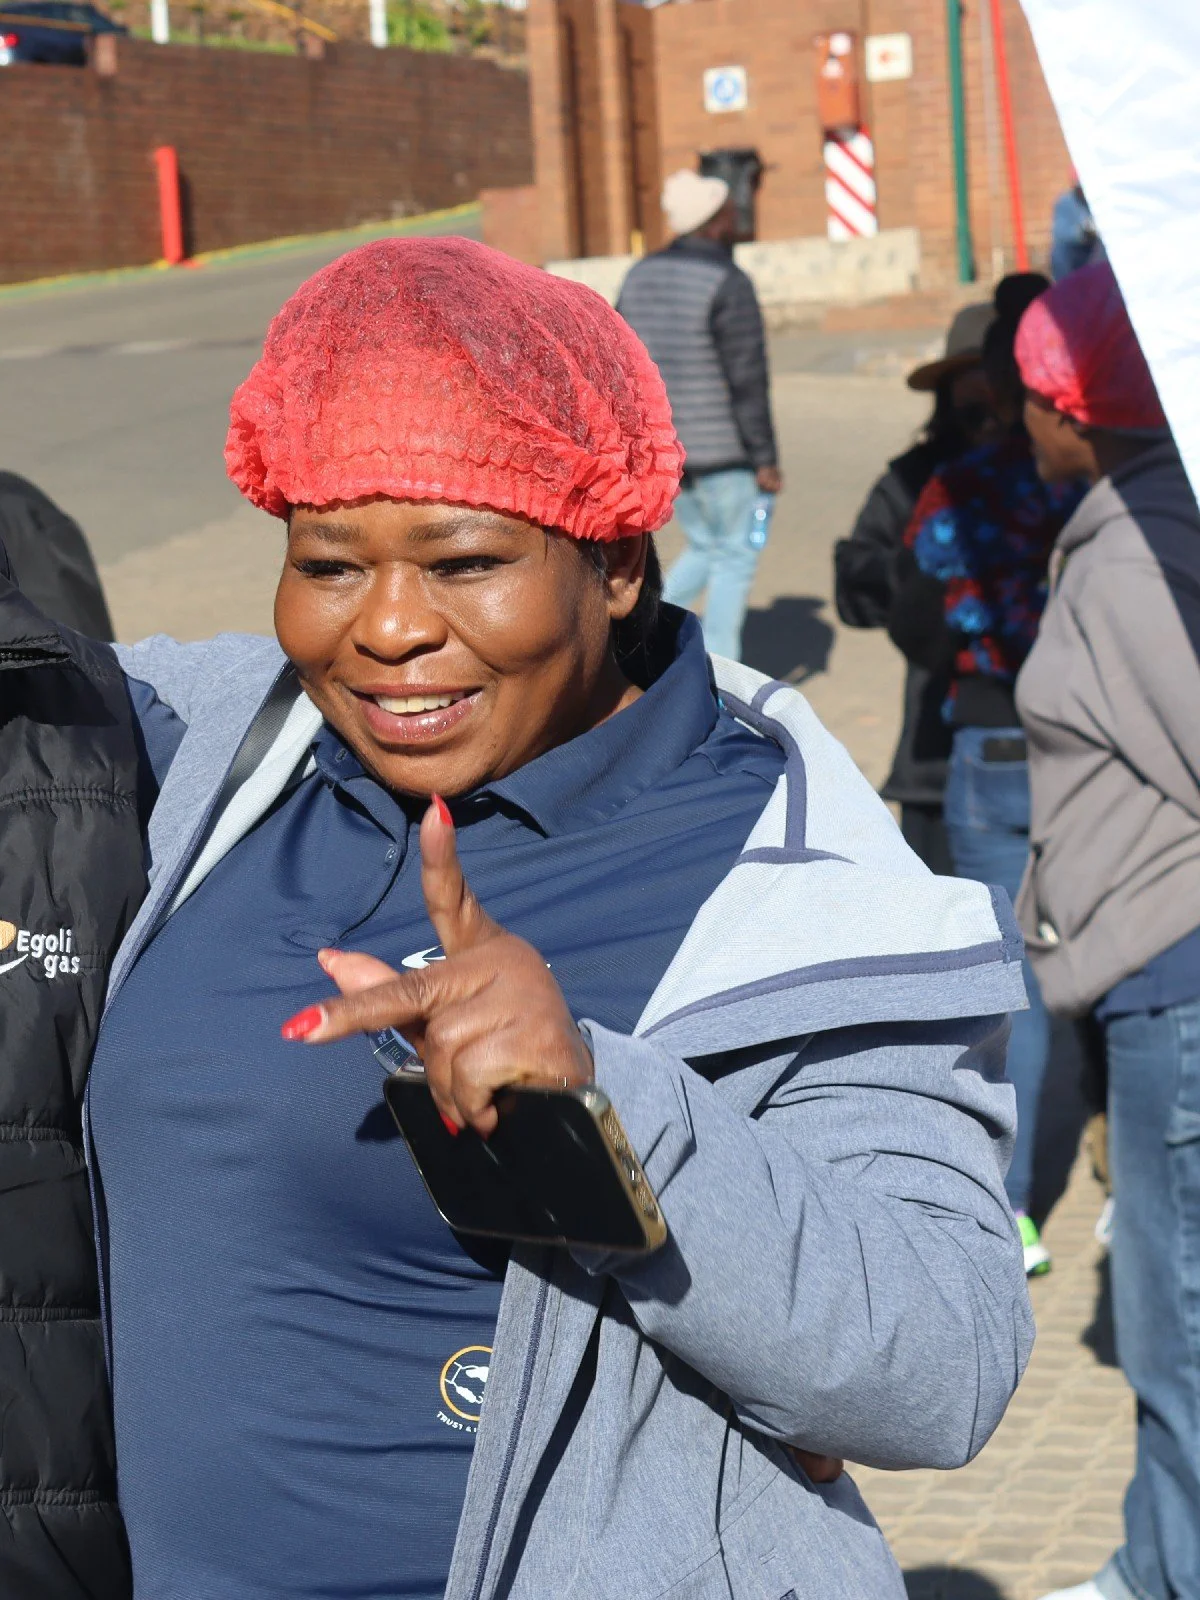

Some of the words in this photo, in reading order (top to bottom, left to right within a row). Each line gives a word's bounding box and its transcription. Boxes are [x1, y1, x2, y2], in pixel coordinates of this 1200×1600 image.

[17, 928, 72, 958] Egoli
[44, 954, 81, 979] gas
[436, 1410, 464, 1431] TRUST
